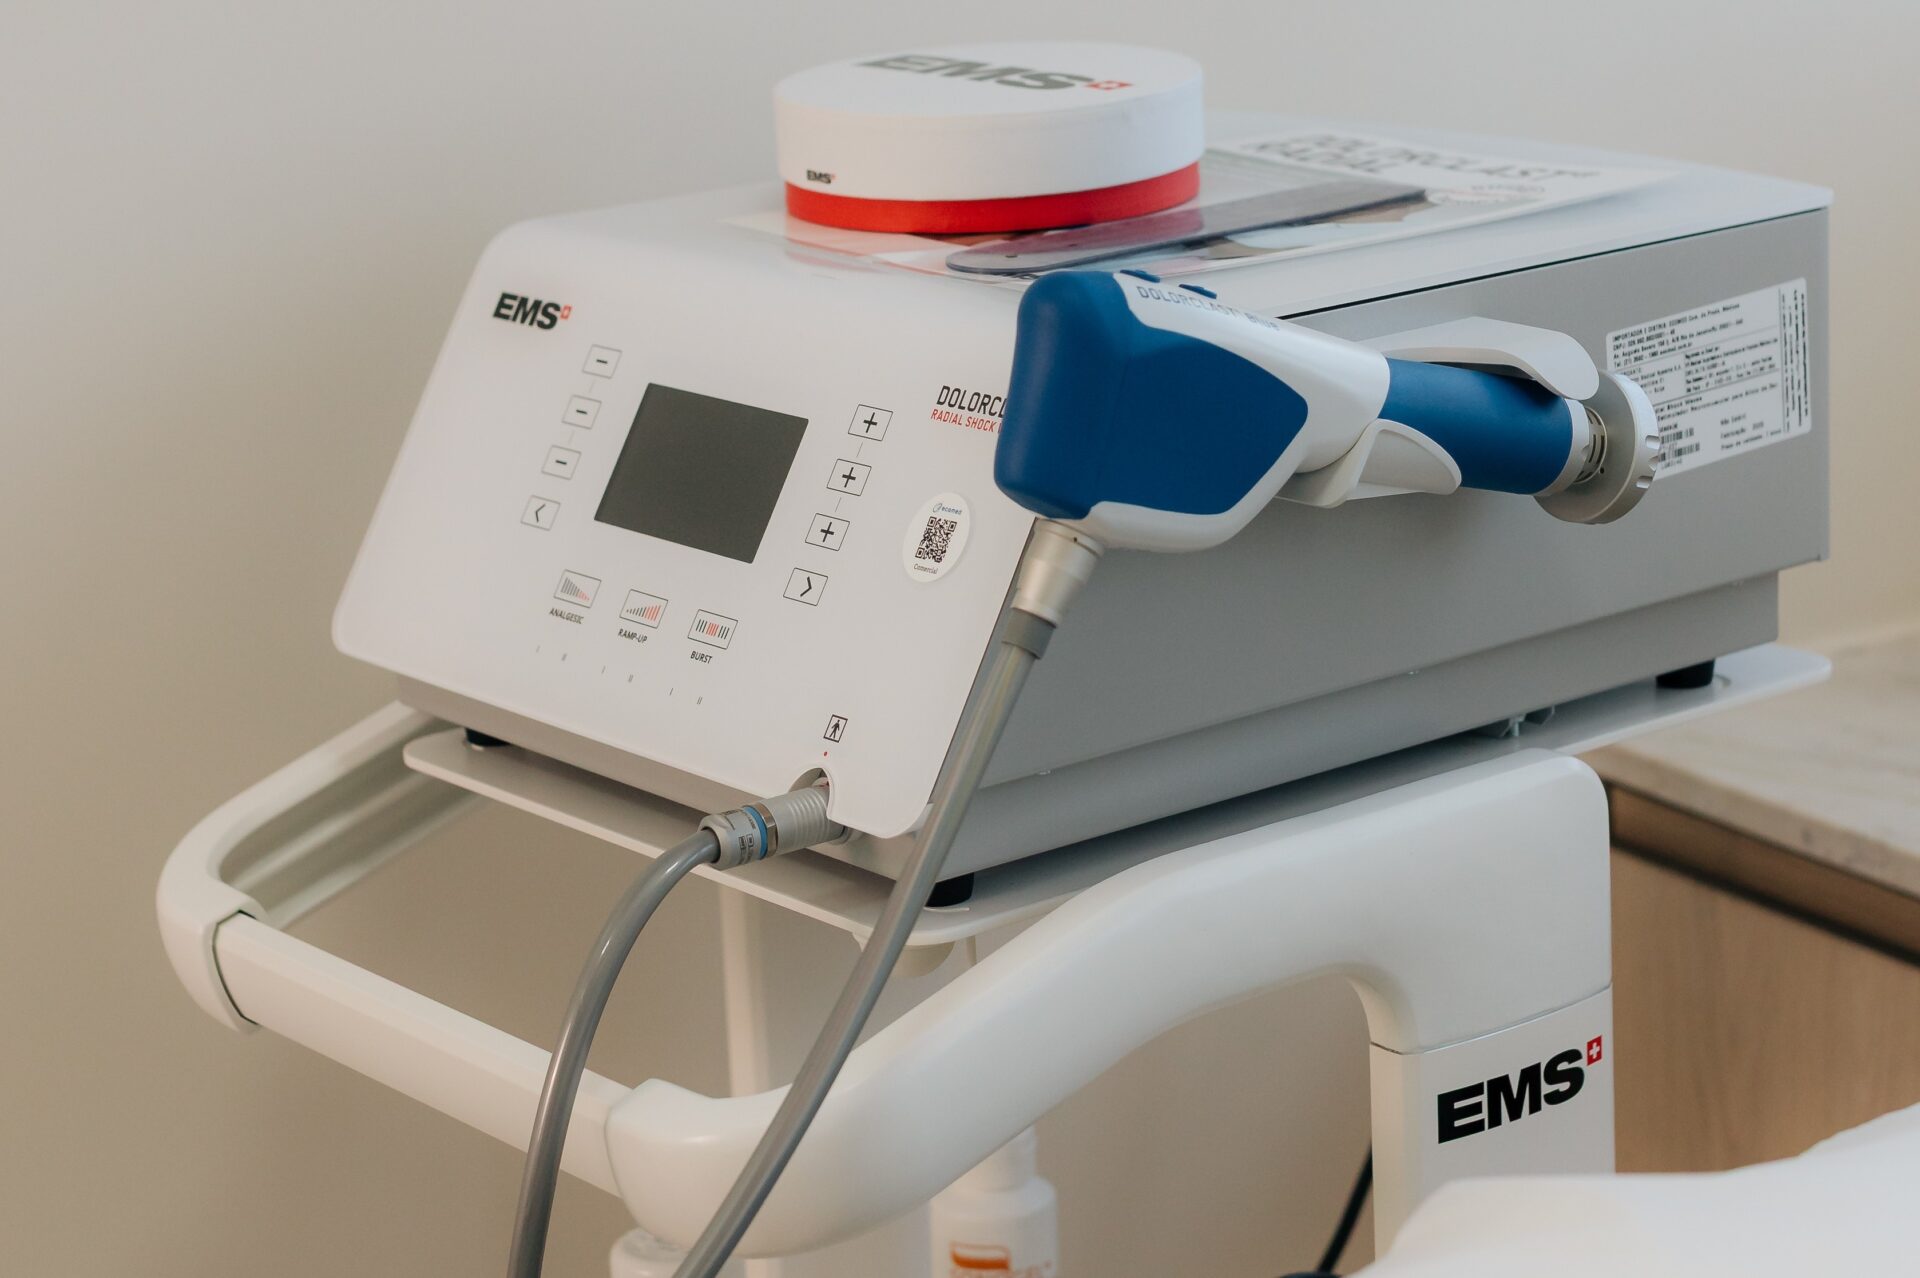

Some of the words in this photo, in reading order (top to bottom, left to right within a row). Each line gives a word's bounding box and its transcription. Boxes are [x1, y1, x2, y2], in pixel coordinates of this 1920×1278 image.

[855, 54, 1095, 90] EMS
[806, 168, 832, 184] EMS
[493, 291, 561, 330] EMS
[931, 408, 963, 426] RADIAL
[965, 416, 997, 433] SHOCK
[913, 562, 939, 575] Comercial
[549, 607, 585, 625] ANALGESIC
[618, 628, 648, 645] RAMP-UP
[690, 650, 713, 665] BURST
[1437, 1048, 1585, 1144] EMS
